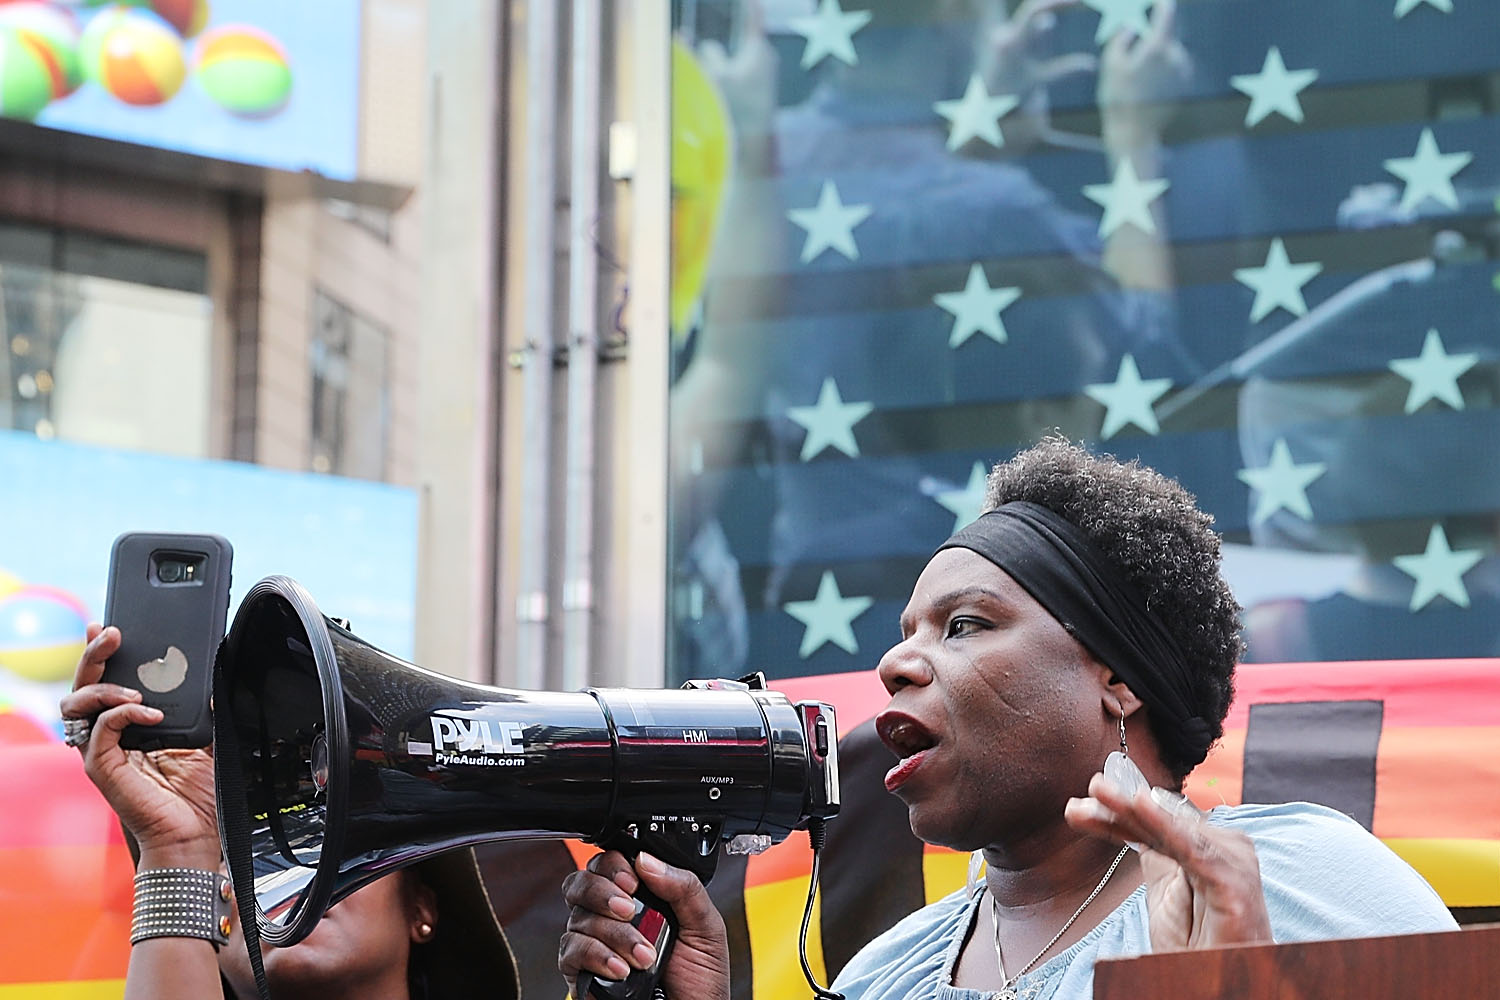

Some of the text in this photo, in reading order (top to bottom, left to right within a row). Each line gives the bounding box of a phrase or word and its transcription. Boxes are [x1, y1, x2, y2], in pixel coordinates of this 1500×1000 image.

[430, 716, 525, 754] PYLE
[682, 729, 708, 743] HMI
[435, 752, 525, 767] PyleAudio.com
[700, 776, 734, 785] AUX/MP3
